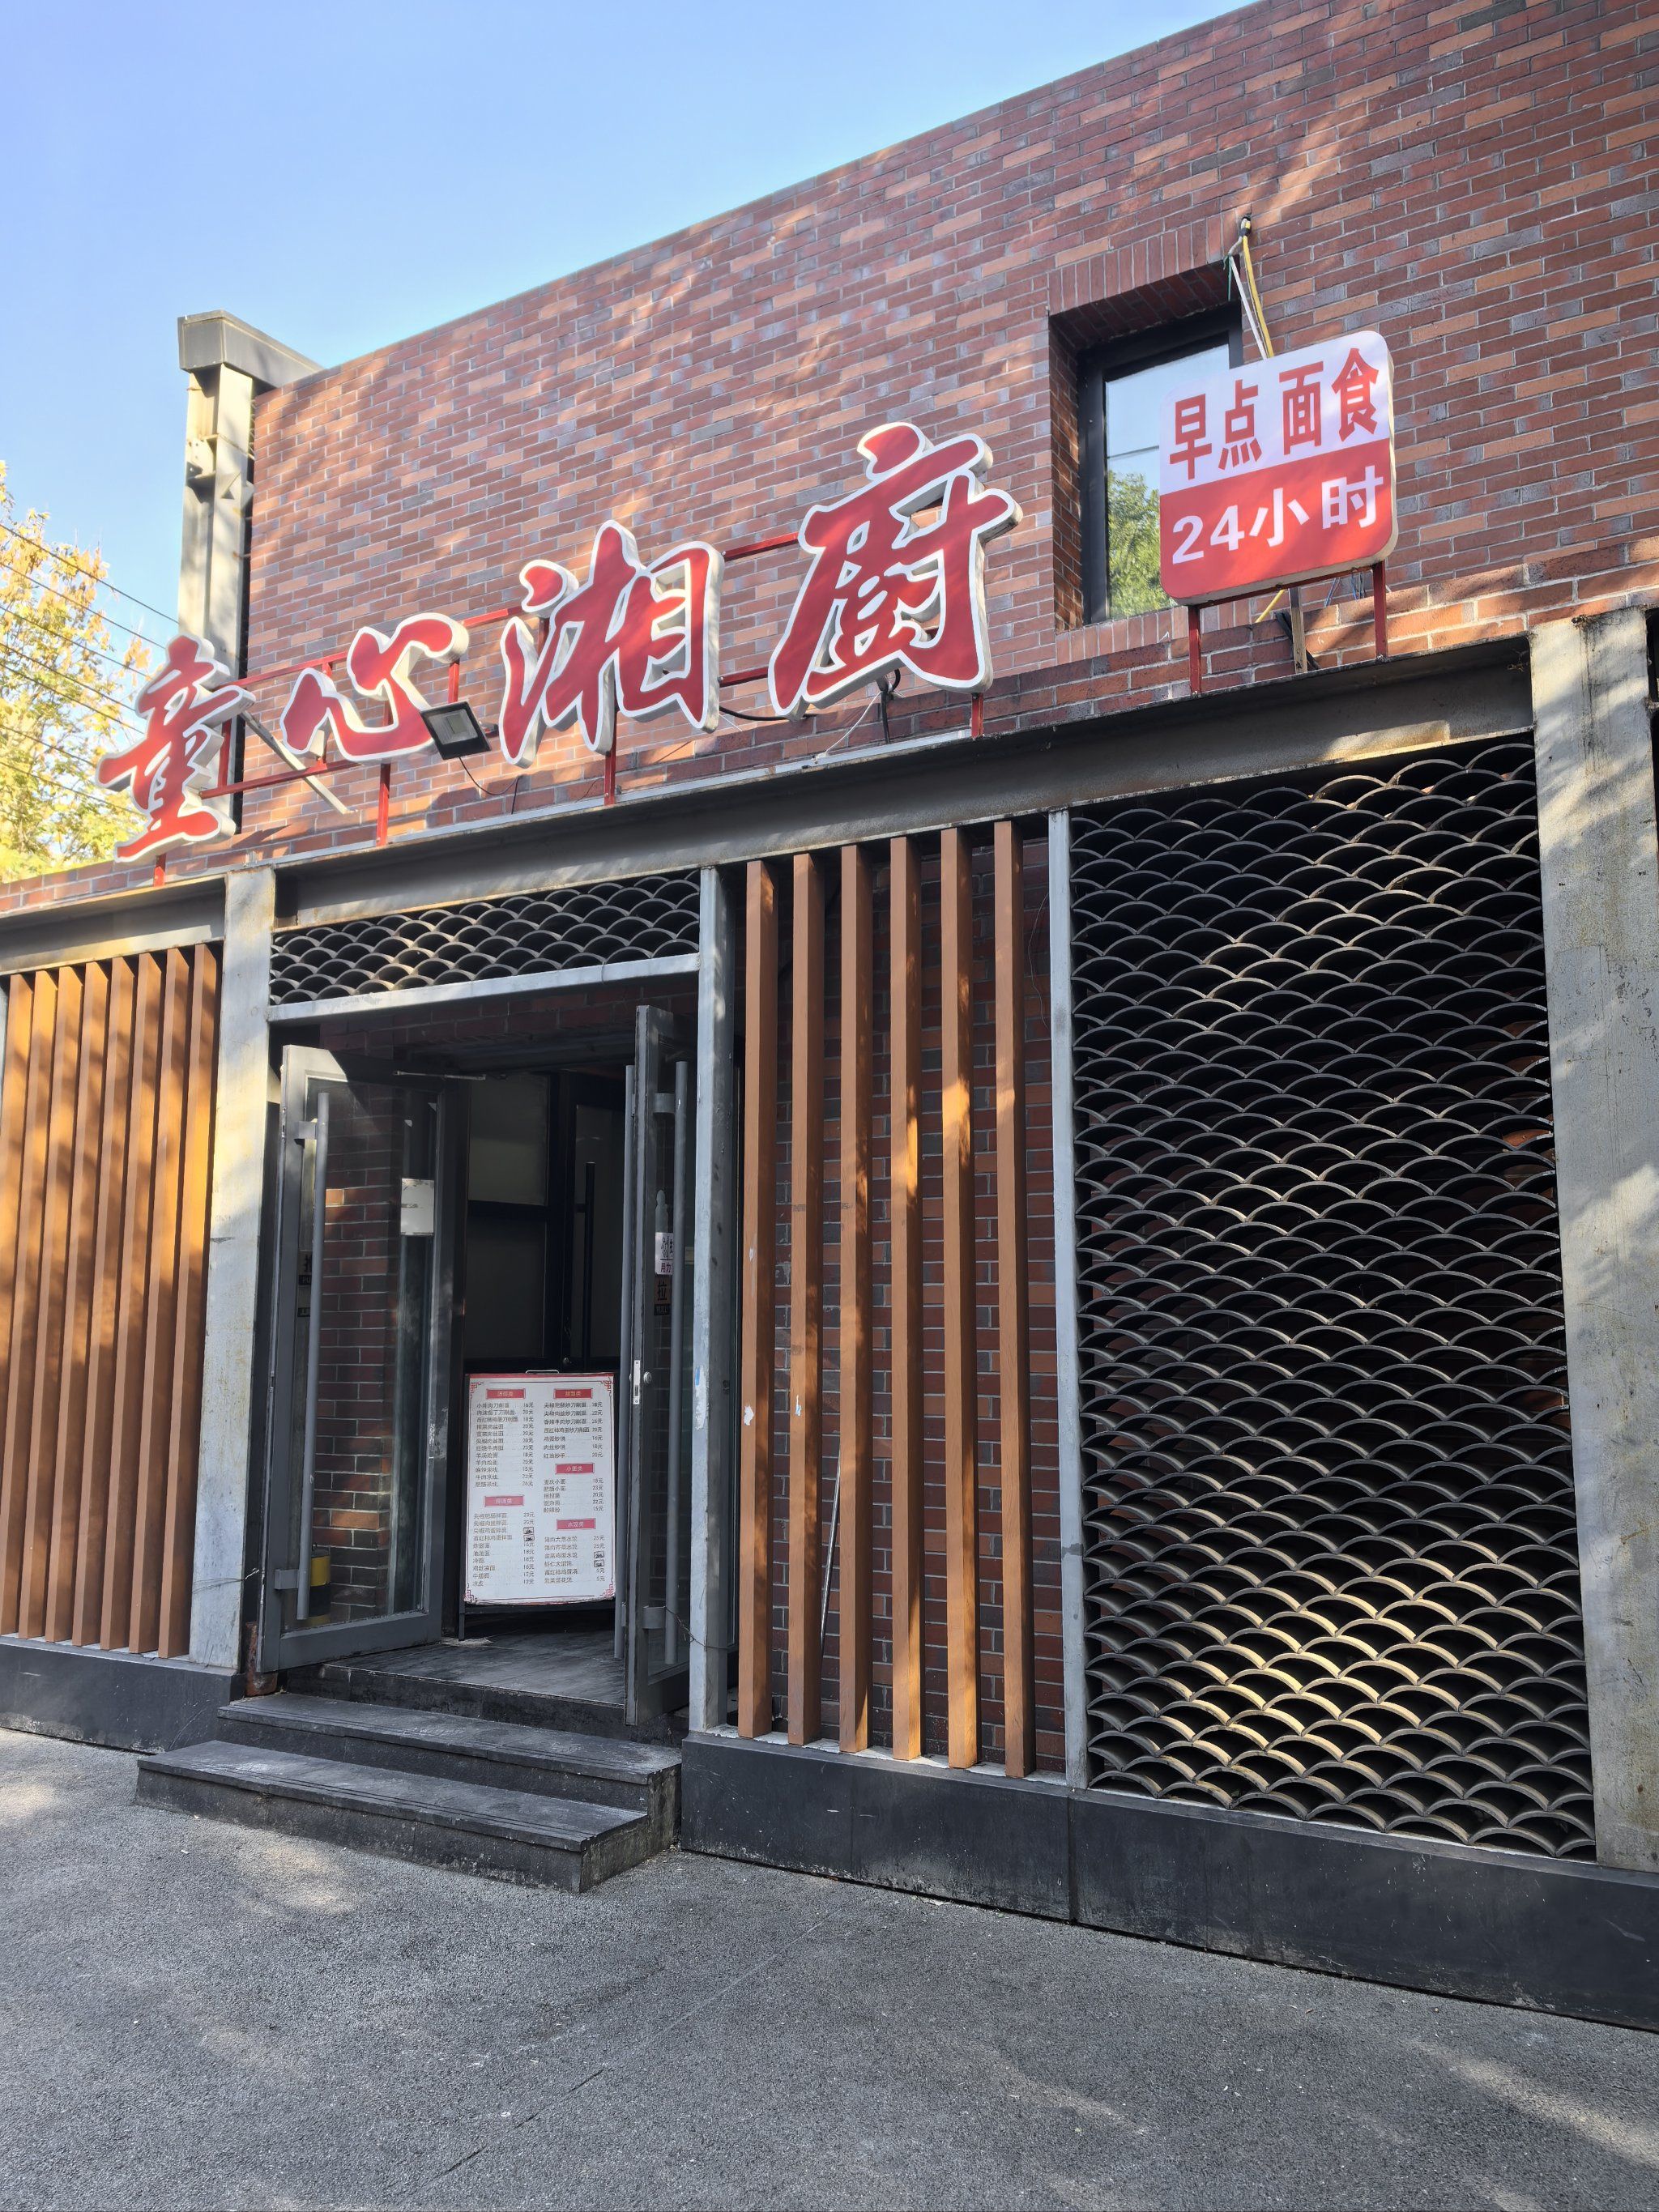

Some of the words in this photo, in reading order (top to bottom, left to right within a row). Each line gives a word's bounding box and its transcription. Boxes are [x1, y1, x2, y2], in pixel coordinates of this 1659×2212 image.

[1172, 465, 1384, 565] 24小时
[661, 1263, 673, 1272] 用力
[658, 1279, 667, 1301] 拉
